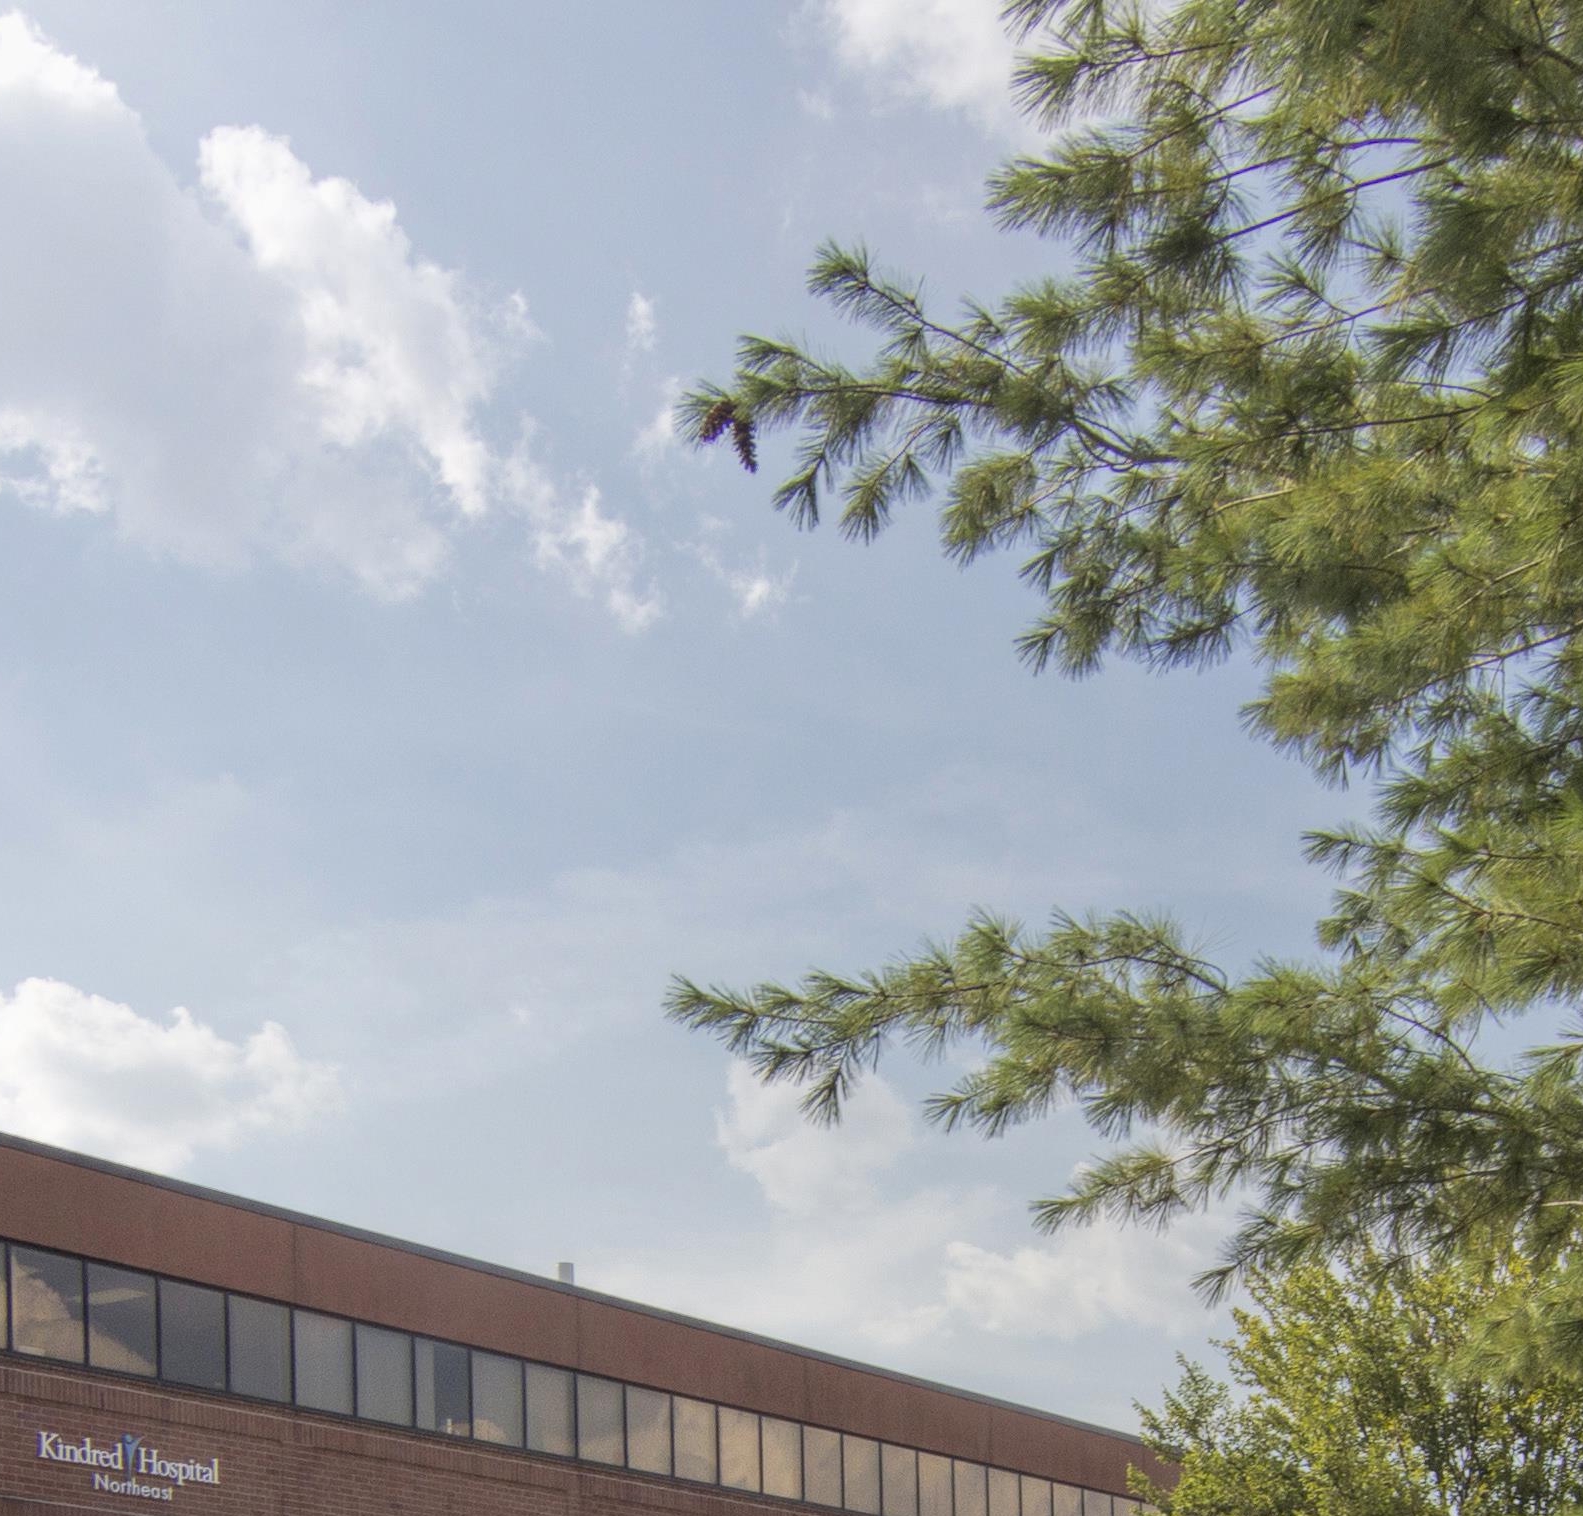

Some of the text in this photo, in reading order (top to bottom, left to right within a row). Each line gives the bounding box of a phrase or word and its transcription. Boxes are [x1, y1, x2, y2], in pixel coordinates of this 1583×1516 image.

[38, 1431, 220, 1486] Kindred Hospital
[93, 1473, 174, 1501] Northeast
